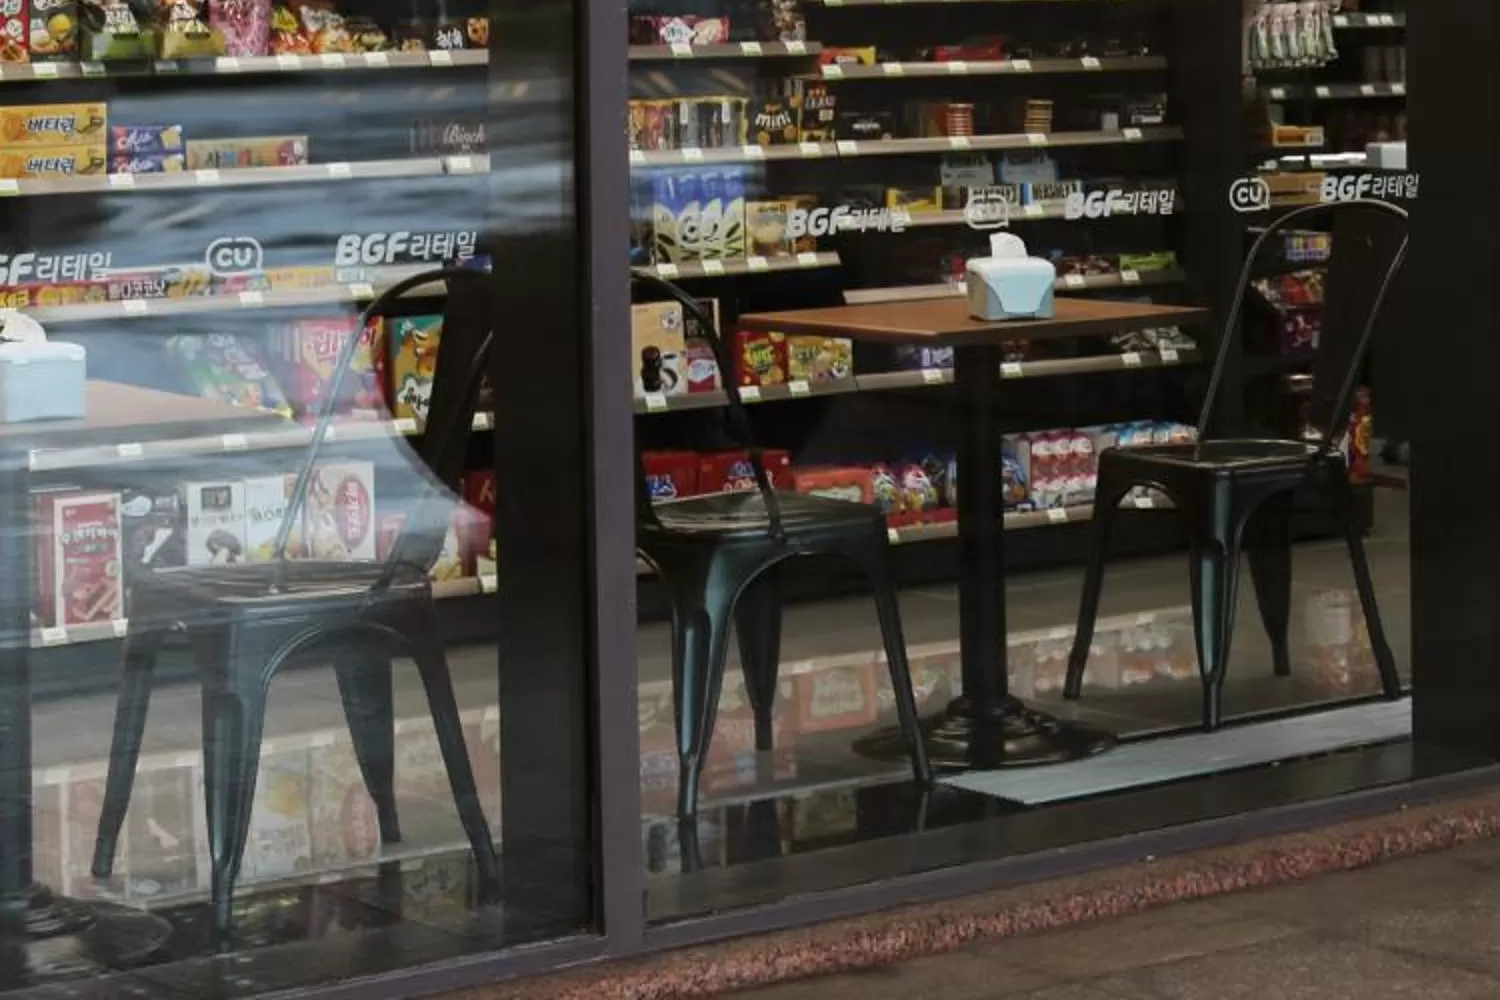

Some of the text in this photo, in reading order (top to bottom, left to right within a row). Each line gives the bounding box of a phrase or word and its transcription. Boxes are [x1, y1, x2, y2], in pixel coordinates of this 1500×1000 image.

[1319, 173, 1419, 203] BGF리테일
[1064, 188, 1176, 220] BGF리테일
[785, 206, 907, 237] BGF리테일
[335, 231, 477, 266] BGF리테일
